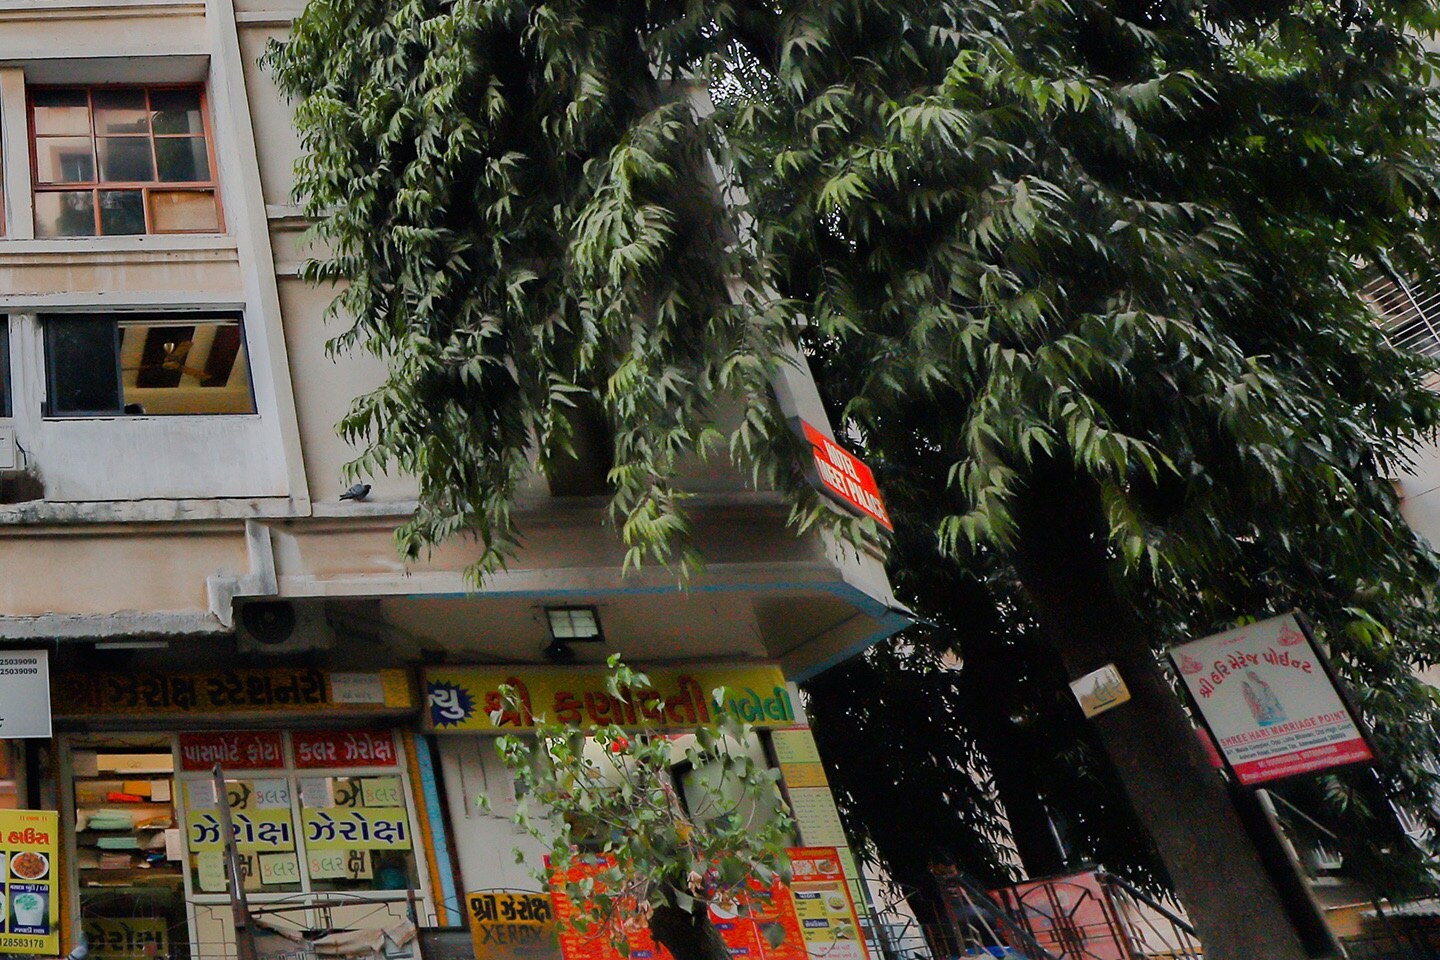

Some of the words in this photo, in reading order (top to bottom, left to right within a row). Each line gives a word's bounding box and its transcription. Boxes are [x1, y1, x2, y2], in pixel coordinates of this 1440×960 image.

[815, 454, 850, 496] MEET
[823, 440, 861, 483] HOTEL
[1199, 677, 1215, 698] શ્રી
[1220, 733, 1248, 746] SHREE
[1248, 728, 1271, 740] HARI
[1271, 717, 1317, 734] MARRIAGE
[1317, 710, 1346, 723] POINT
[299, 741, 337, 761] કલર
[344, 733, 392, 762] ઝેરોક્ષ
[8, 828, 50, 845] હાઉસ
[193, 814, 290, 845] ઝેરોક્ષ
[308, 812, 405, 844] ઝેરોક્ષ
[471, 895, 498, 922] શ્રી
[501, 895, 552, 923] ઝેરોક્ષ
[480, 924, 543, 944] XEROX
